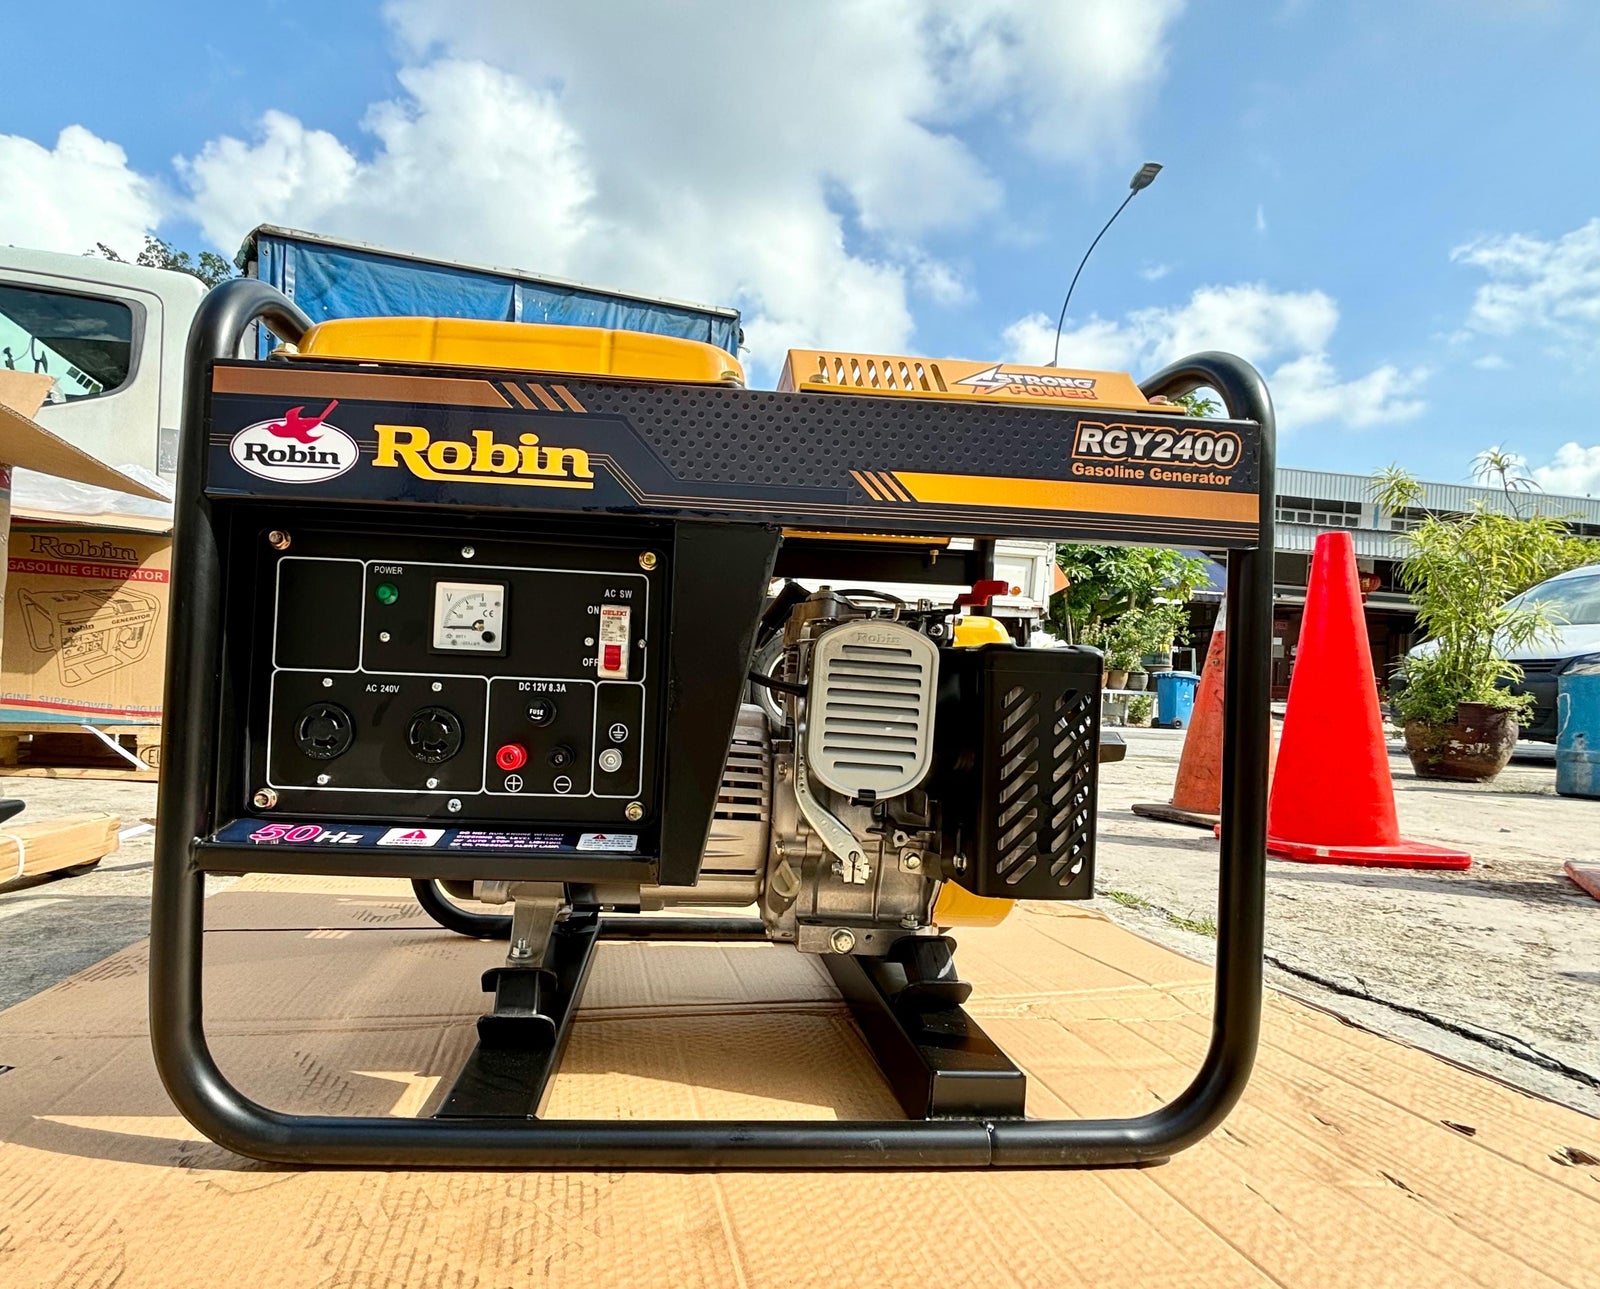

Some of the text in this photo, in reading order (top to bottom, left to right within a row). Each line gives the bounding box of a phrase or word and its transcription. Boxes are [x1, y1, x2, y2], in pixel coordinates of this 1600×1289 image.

[1007, 384, 1098, 399] POWER
[1077, 426, 1237, 464] RGY2400
[243, 442, 341, 470] Robin
[372, 424, 594, 490] Robin
[1071, 462, 1233, 486] Gasoline Generator
[30, 534, 139, 565] Robin
[8, 560, 164, 581] GASOLINE GENERATOR
[374, 566, 403, 575] POWER
[446, 593, 452, 602] V
[604, 589, 632, 599] AC SW
[587, 606, 600, 615] ON
[111, 613, 151, 625] GENERATOR
[67, 623, 95, 634] Robin
[857, 632, 902, 646] Robin
[582, 657, 599, 667] OFF
[365, 684, 400, 693] AC 240V
[518, 682, 567, 693] DC 12V 8.3A
[529, 708, 544, 716] FUSE
